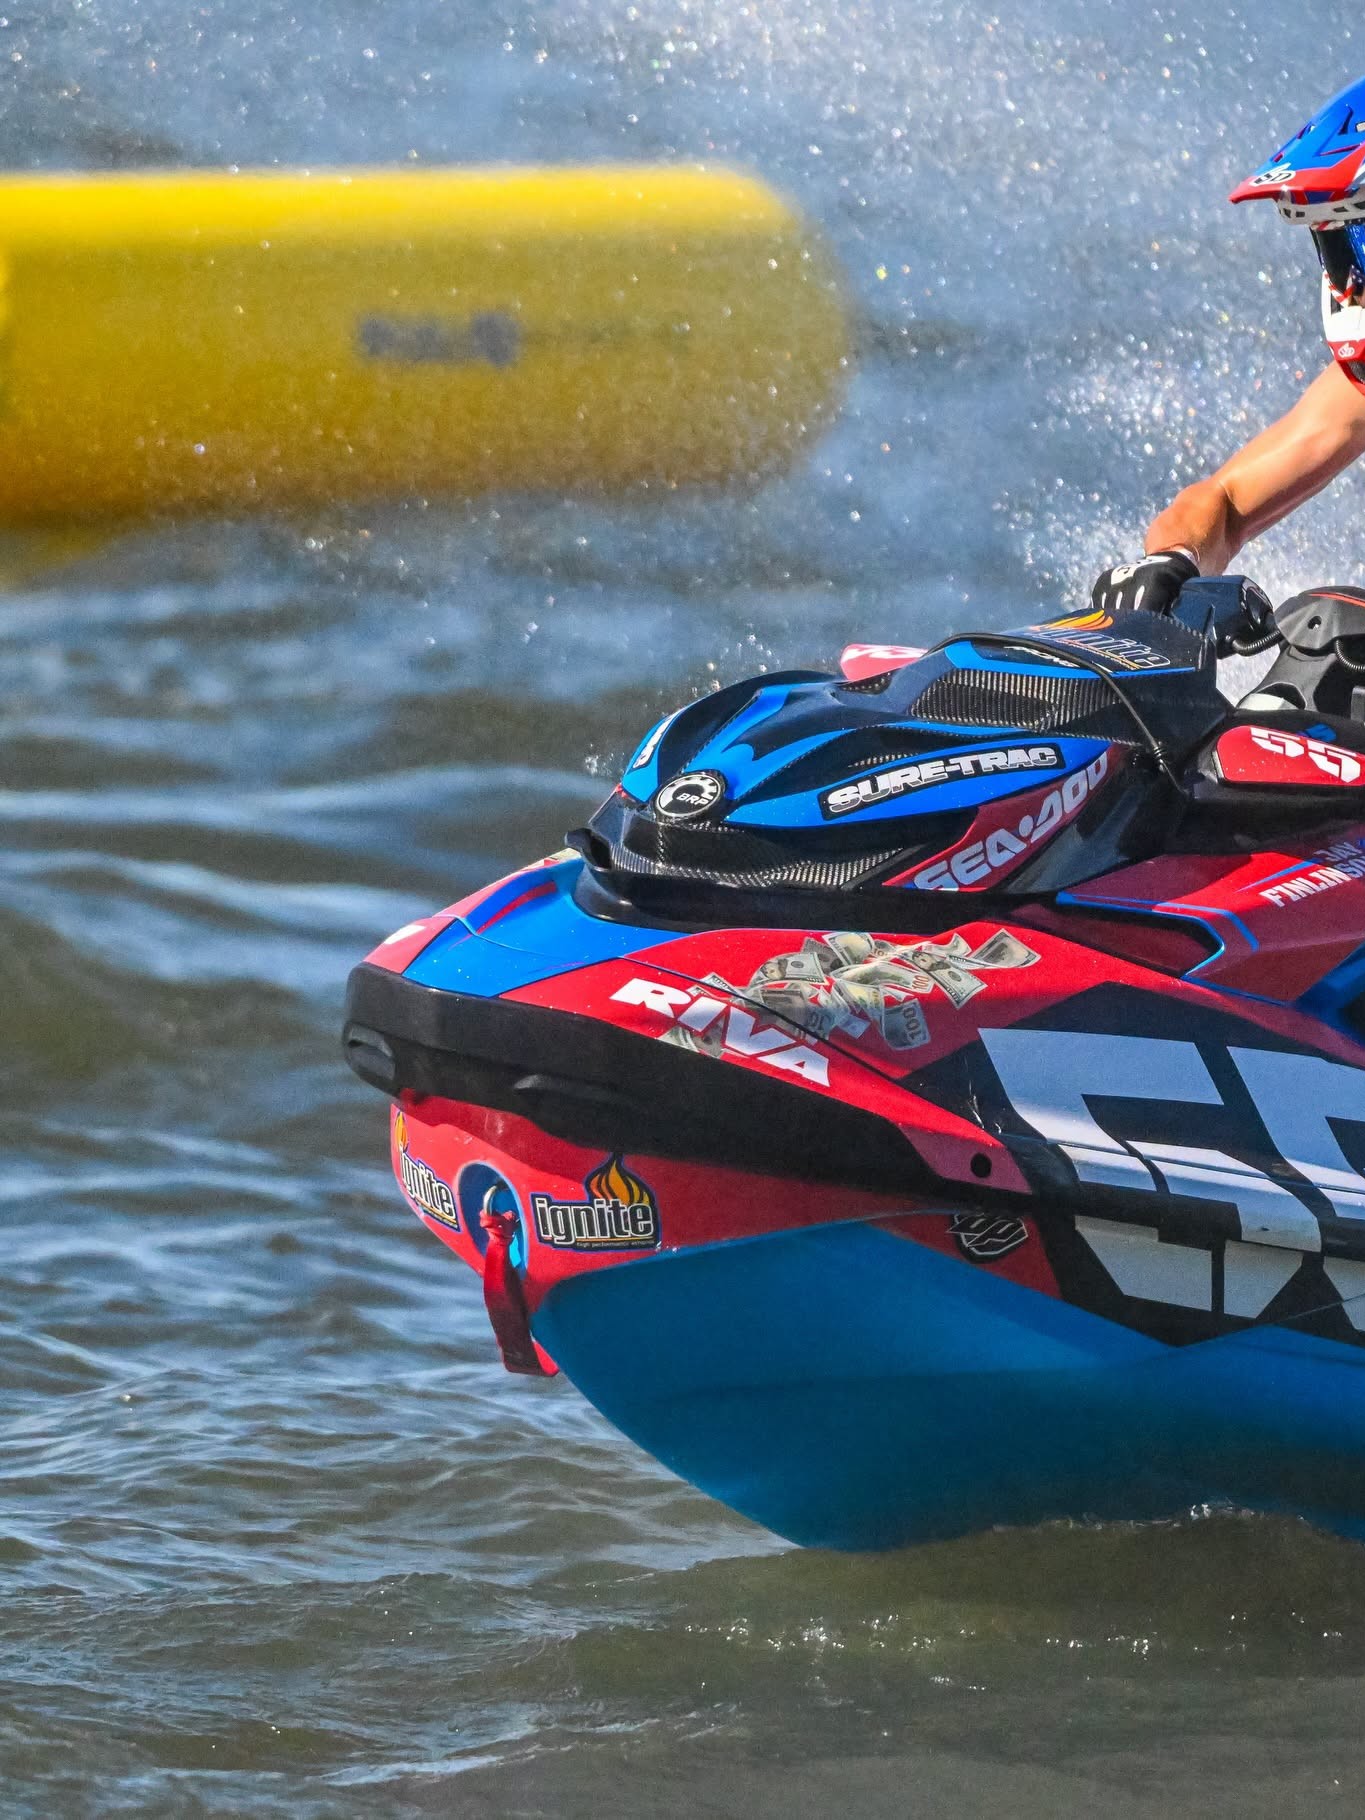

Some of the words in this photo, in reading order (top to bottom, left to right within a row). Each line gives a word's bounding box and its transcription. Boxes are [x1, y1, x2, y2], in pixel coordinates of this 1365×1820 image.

[827, 747, 1057, 813] SURE-TRAC
[1251, 726, 1361, 783] 55
[676, 793, 709, 807] BRP
[609, 977, 830, 1088] RIVA
[535, 1198, 654, 1245] ignite
